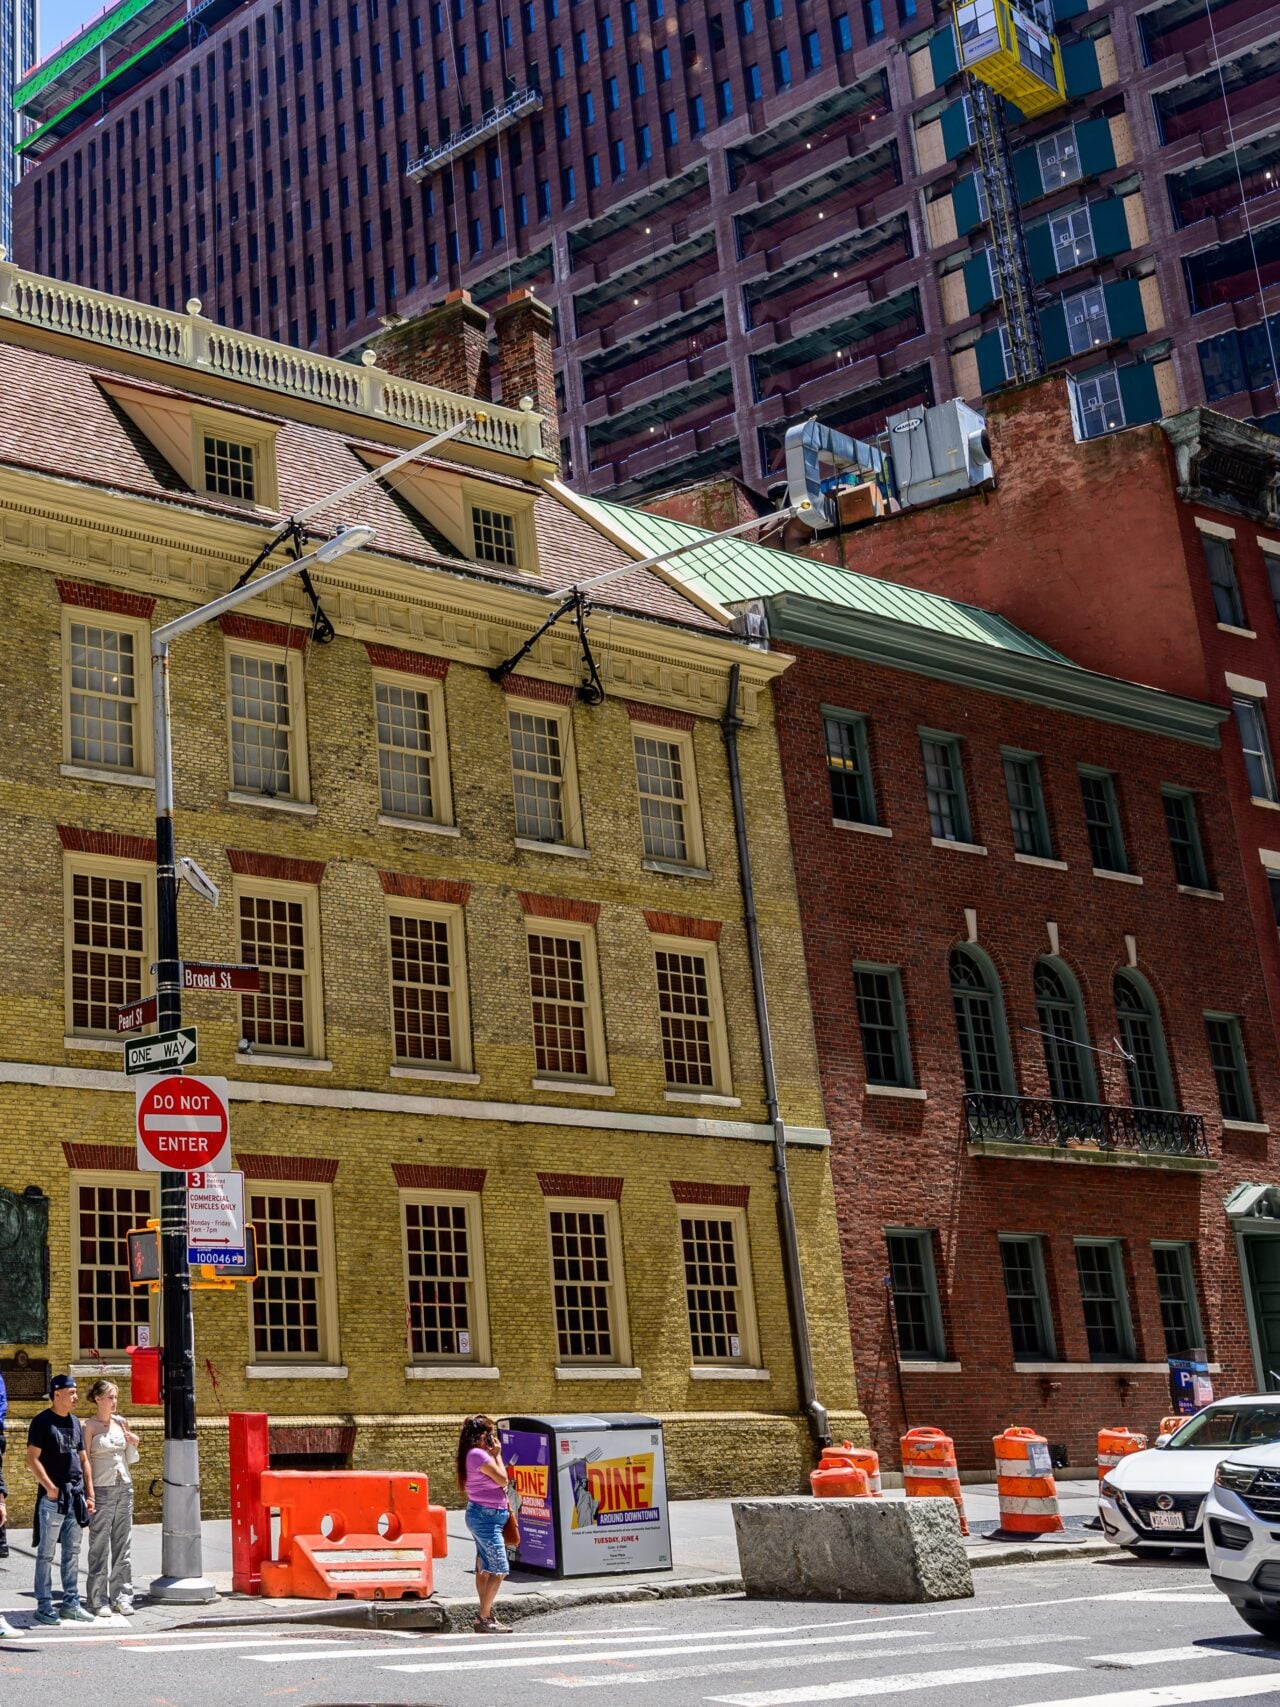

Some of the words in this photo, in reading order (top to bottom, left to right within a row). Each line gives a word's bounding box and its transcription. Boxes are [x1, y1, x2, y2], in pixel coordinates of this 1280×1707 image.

[185, 969, 216, 988] Broad
[220, 971, 232, 989] St
[118, 1012, 134, 1030] Pearl
[135, 1007, 143, 1025] St
[131, 1047, 152, 1064] ONE
[163, 1040, 187, 1058] WAY
[153, 1094, 174, 1110] DO
[180, 1095, 210, 1111] NOT
[158, 1136, 209, 1152] ENTER
[191, 1172, 201, 1187] 3
[190, 1194, 230, 1202] COMMERCIAL
[190, 1202, 220, 1210] VEHICLES
[220, 1203, 236, 1211] ONLY
[190, 1219, 210, 1227] Monday
[215, 1220, 231, 1228] Friday
[196, 1253, 231, 1264] 100046
[515, 1470, 546, 1496] DINE
[587, 1466, 648, 1512] DINE
[522, 1496, 545, 1508] AROUND
[521, 1506, 550, 1518] DOWNTOWN
[600, 1513, 624, 1524] AROUND
[624, 1510, 658, 1522] DOWNTOWN
[593, 1536, 620, 1545] TUESDAY,
[620, 1535, 634, 1543] JUNE
